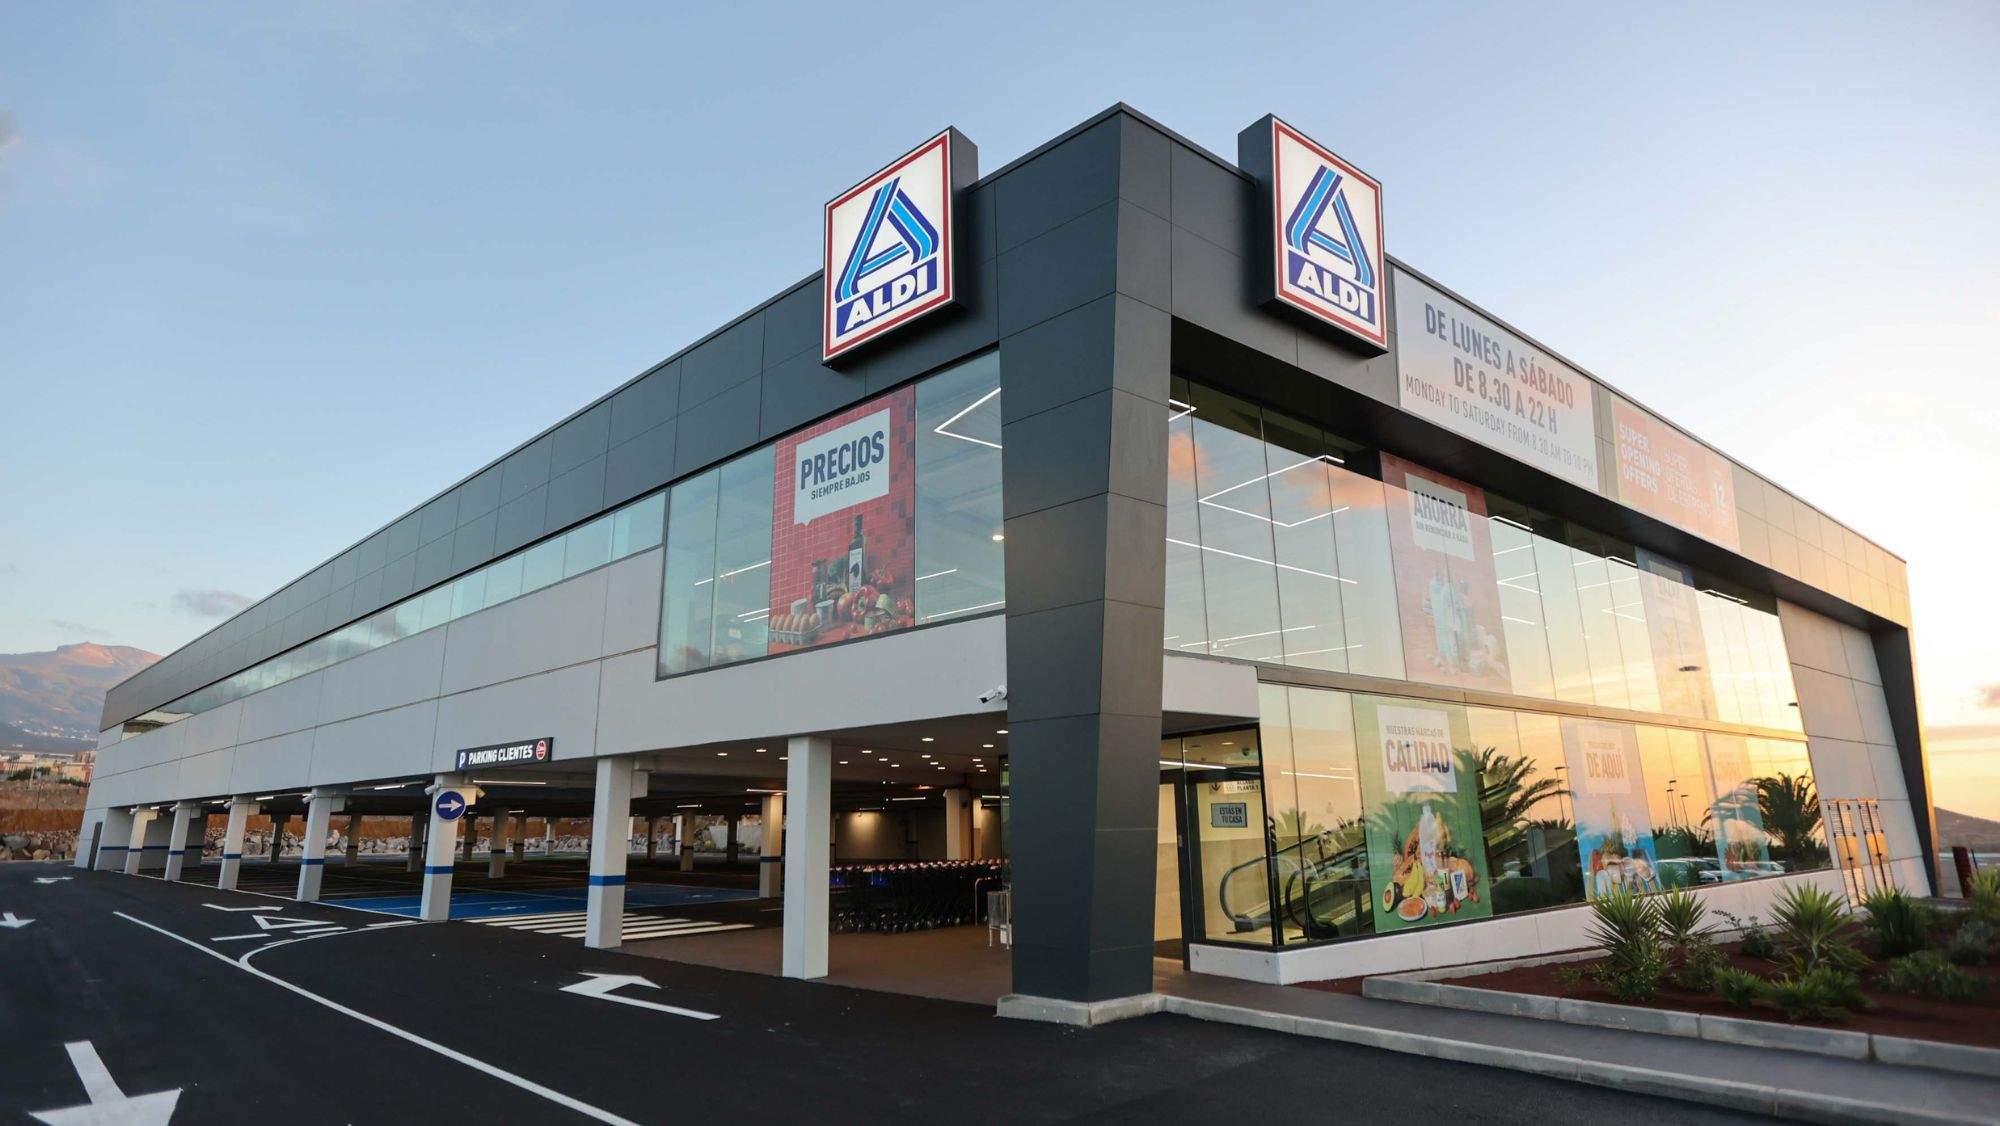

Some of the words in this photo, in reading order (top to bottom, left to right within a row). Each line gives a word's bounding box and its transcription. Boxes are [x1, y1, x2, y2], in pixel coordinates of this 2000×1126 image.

[844, 264, 928, 332] ALDI
[1297, 261, 1369, 320] ALDI
[1425, 303, 1447, 341] DE
[1451, 318, 1501, 371] LUNES
[1506, 350, 1516, 379] A
[1520, 356, 1573, 409] SÁBADO
[1454, 357, 1474, 393] DE
[1479, 370, 1510, 411] 8.30
[1515, 390, 1525, 419] A
[1528, 396, 1545, 429] 22
[1548, 406, 1557, 434] H
[1405, 374, 1445, 408] MONDAY
[1449, 394, 1459, 414] TO
[1463, 401, 1504, 436] SATURDAY
[1508, 422, 1529, 447] FROM
[1550, 441, 1561, 463] AM
[1619, 423, 1649, 450] SUPER
[801, 430, 885, 490] PRECIOS
[1621, 444, 1660, 477] OPENING
[811, 479, 843, 500] SIEMPRE
[844, 471, 871, 490] BAJOS
[1623, 464, 1658, 494] OFFERS
[1414, 490, 1467, 532] AHORRA
[459, 752, 466, 768] P
[468, 749, 498, 765] PARKING
[498, 744, 533, 762] CLIENTES
[1386, 739, 1450, 774] CALIDAD
[1586, 751, 1600, 778] DE
[1222, 815, 1229, 824] TU
[1230, 815, 1243, 824] CASA
